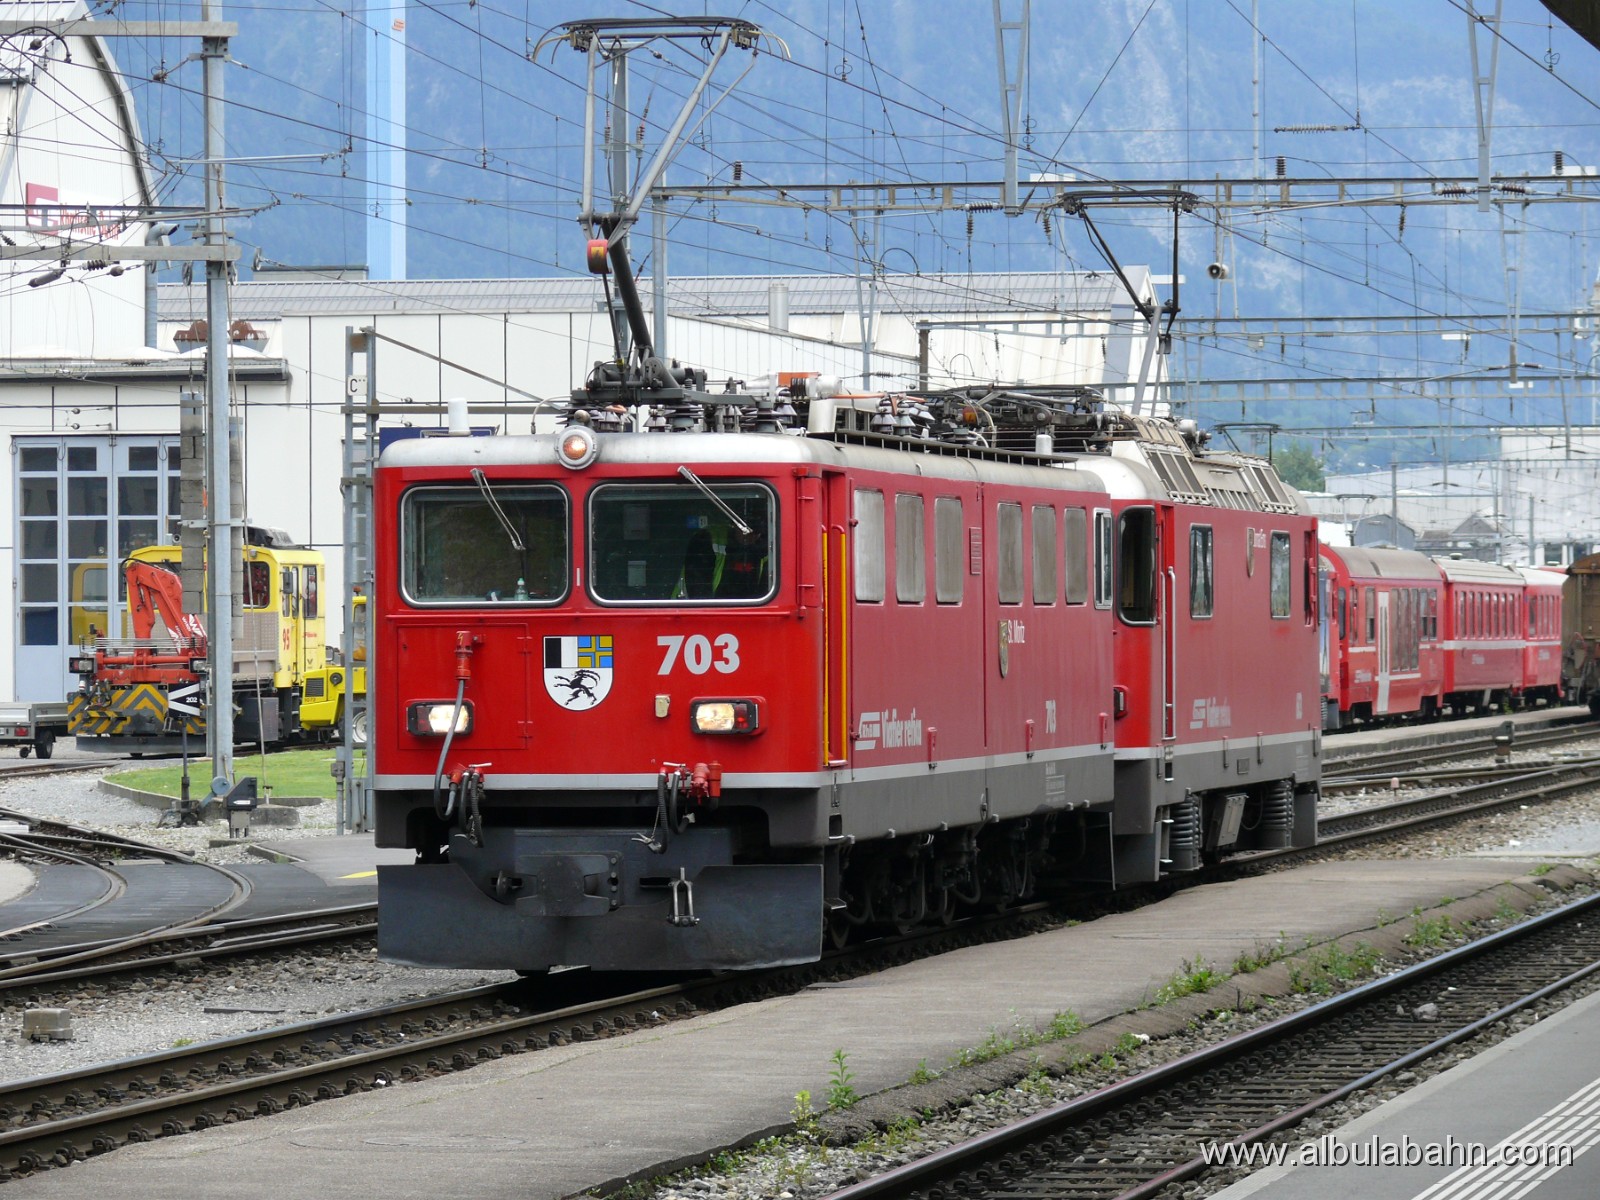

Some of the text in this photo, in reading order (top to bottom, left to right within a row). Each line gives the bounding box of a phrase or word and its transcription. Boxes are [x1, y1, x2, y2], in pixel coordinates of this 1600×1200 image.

[283, 628, 290, 651] 95
[1014, 620, 1026, 643] Moritz
[657, 633, 740, 675] 703
[1045, 699, 1057, 734] 703
